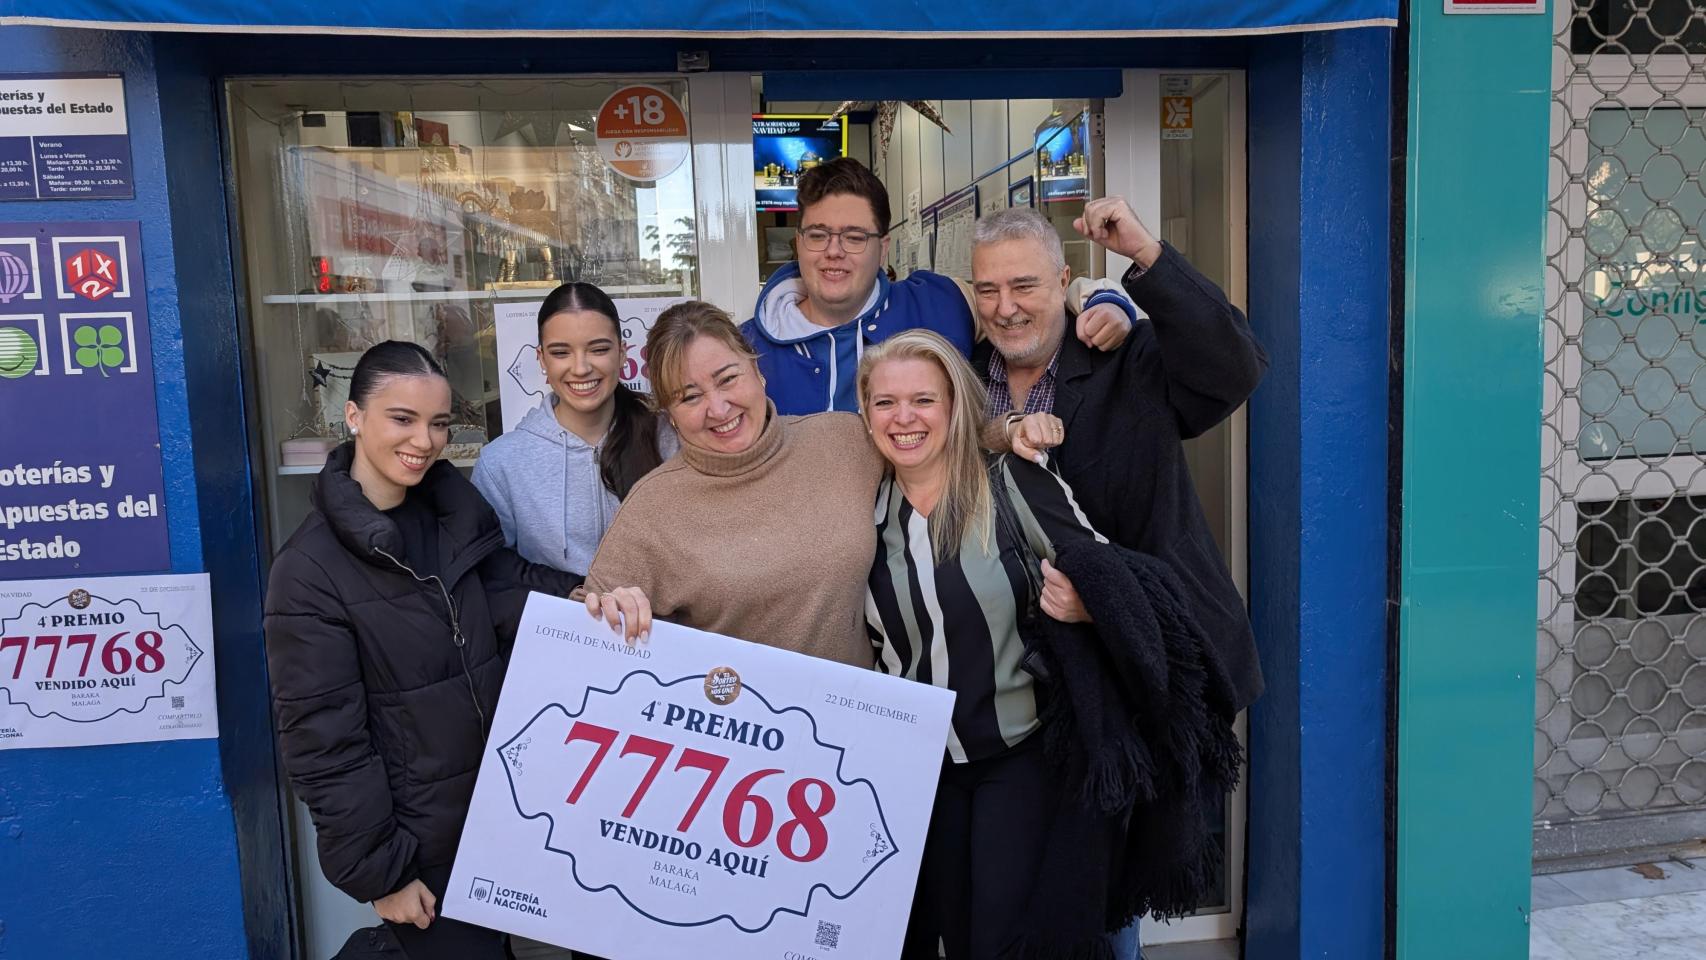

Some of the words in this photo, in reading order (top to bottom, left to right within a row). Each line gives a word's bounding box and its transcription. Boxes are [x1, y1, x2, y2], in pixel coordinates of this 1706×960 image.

[0, 104, 43, 114] uestas
[46, 103, 66, 114] del
[70, 102, 113, 114] Estado
[37, 92, 44, 102] y
[614, 95, 666, 126] +18
[100, 465, 114, 488] y
[118, 494, 158, 518] del
[51, 612, 125, 627] PREMIO
[536, 625, 581, 644] LOTERÍA
[584, 636, 600, 648] DE
[600, 640, 652, 660] NAVIDAD
[0, 630, 166, 680] 77768
[35, 680, 97, 691] VENDIDO
[100, 674, 136, 690] AQUÍ
[825, 693, 838, 704] 22
[839, 697, 855, 708] DE
[856, 701, 918, 724] DICIEMBRE
[662, 703, 784, 752] PREMIO
[564, 720, 836, 863] 77768
[600, 818, 702, 860] VENDIDO
[706, 847, 770, 878] AQUÍ
[652, 860, 699, 881] BARAKA
[496, 886, 540, 906] LOTERÍA
[648, 875, 698, 896] MALAGA
[494, 896, 548, 918] NACIONAL
